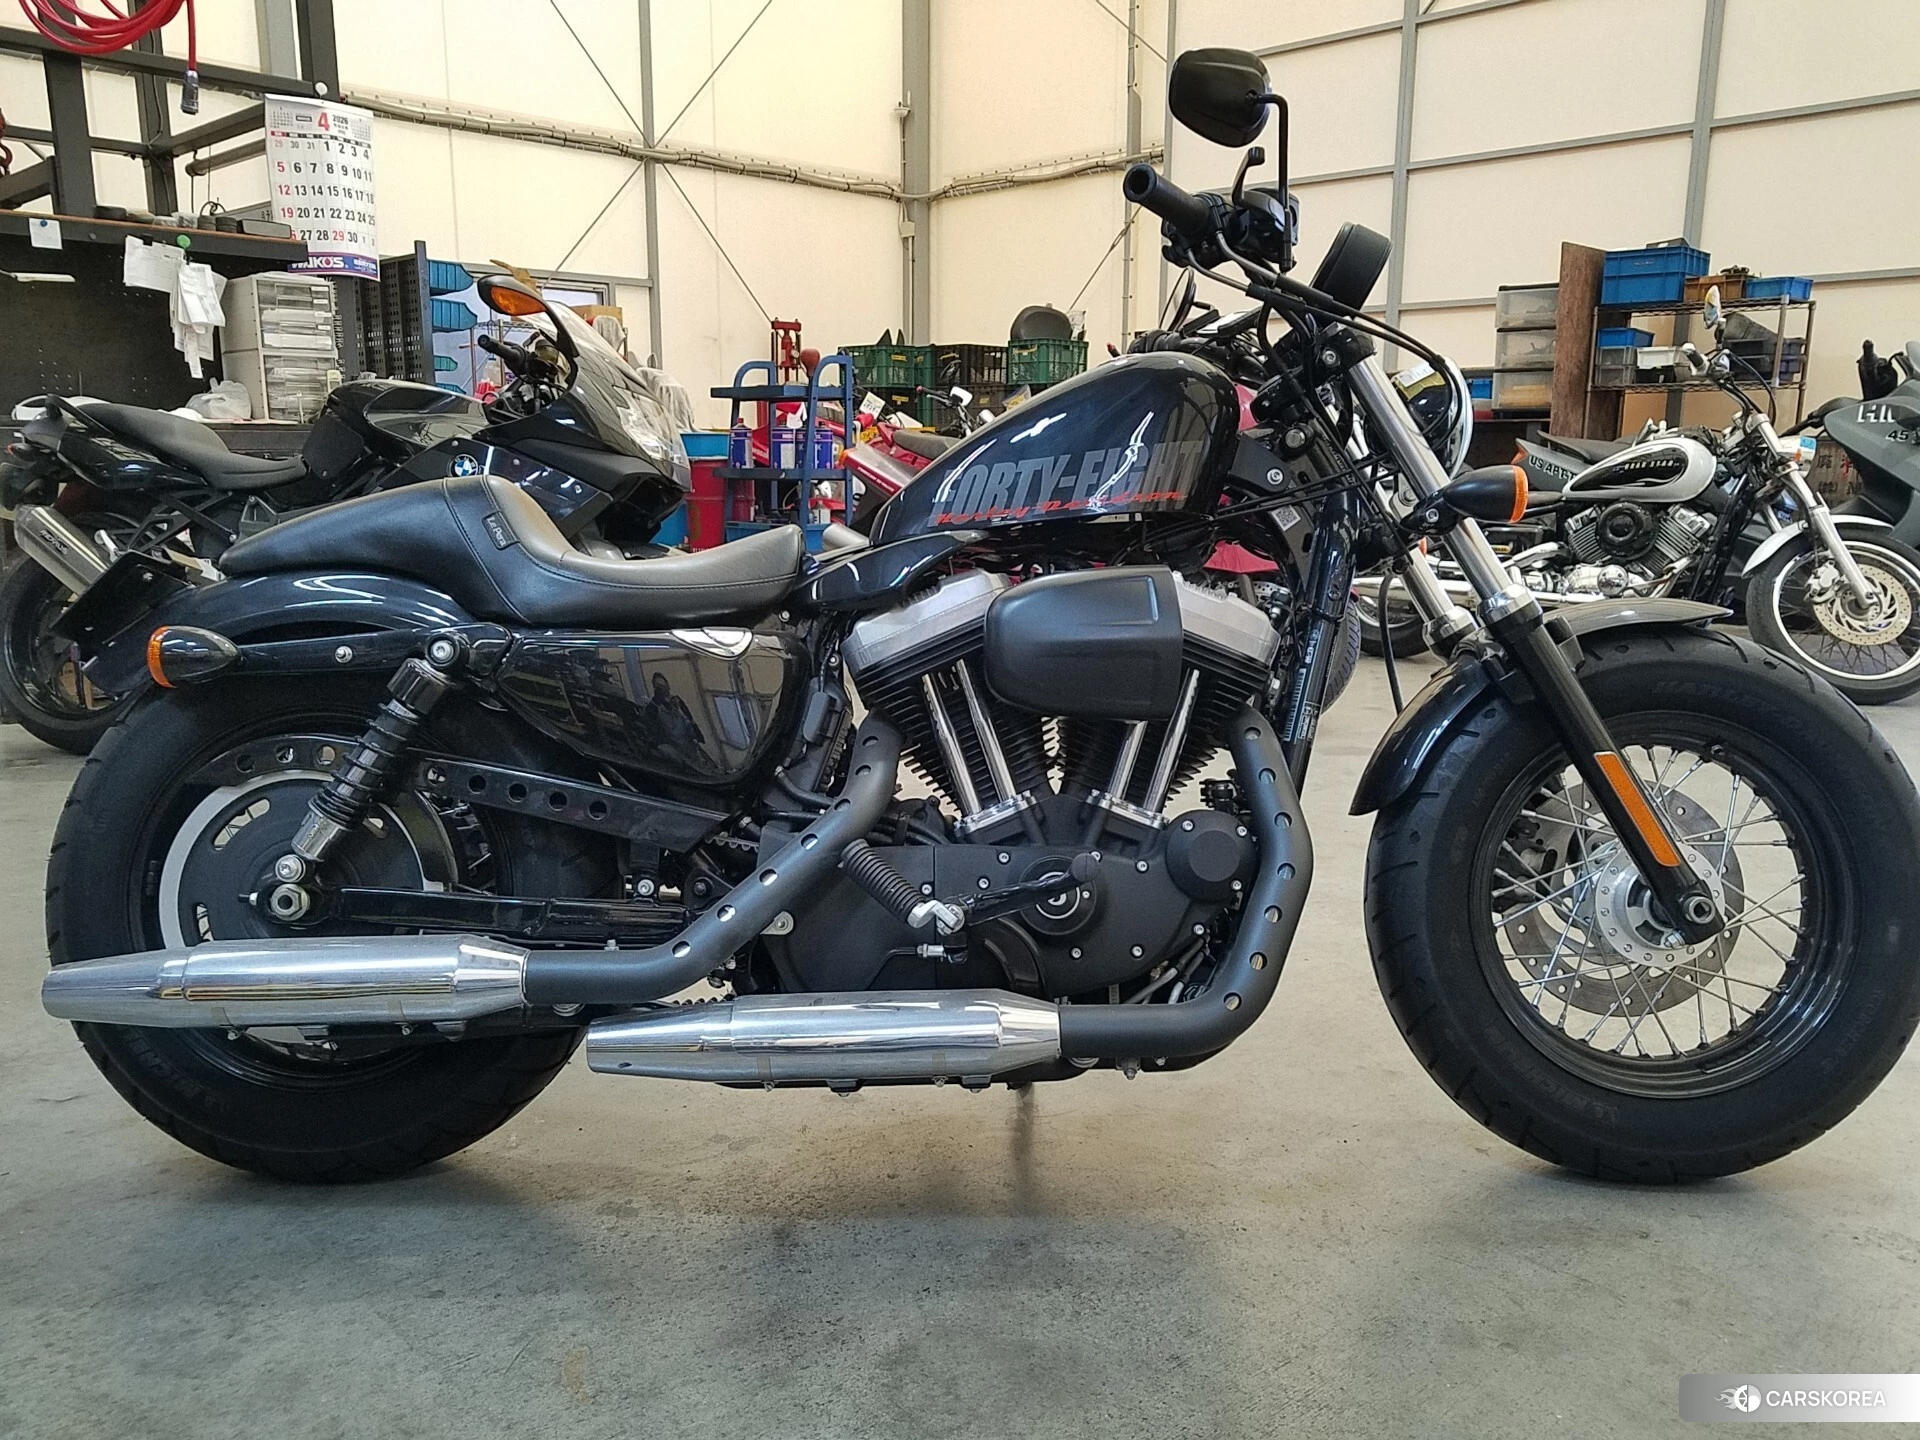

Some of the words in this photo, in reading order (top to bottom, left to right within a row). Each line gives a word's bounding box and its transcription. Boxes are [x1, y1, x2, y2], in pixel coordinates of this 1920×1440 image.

[318, 112, 330, 131] 4
[332, 114, 348, 125] 2026
[290, 141, 300, 149] 30
[307, 142, 315, 150] 31
[324, 141, 330, 151] 1
[338, 143, 345, 154] 2
[351, 146, 357, 157] 3
[363, 149, 369, 160] 4
[277, 162, 285, 172] 5
[294, 162, 302, 173] 6
[310, 163, 317, 173] 7
[326, 163, 334, 174] 8
[341, 165, 348, 176] 9
[352, 168, 362, 180] 10
[364, 170, 372, 182] 11
[278, 185, 291, 196] 12
[295, 185, 307, 196] 13
[311, 185, 323, 196] 14
[327, 186, 339, 197] 15
[342, 188, 352, 199] 16
[355, 190, 363, 202] 17
[366, 193, 374, 204] 18
[281, 207, 294, 218] 19
[297, 208, 310, 218] 20
[313, 208, 325, 218] 21
[329, 208, 342, 219] 22
[345, 210, 355, 220] 23
[357, 212, 366, 223] 24
[368, 214, 376, 226] 25
[300, 230, 312, 240] 27
[316, 230, 329, 240] 28
[332, 231, 345, 240] 29
[347, 232, 358, 243] 30
[1528, 453, 1543, 470] US
[927, 440, 1203, 527] FORTY-EIGHT
